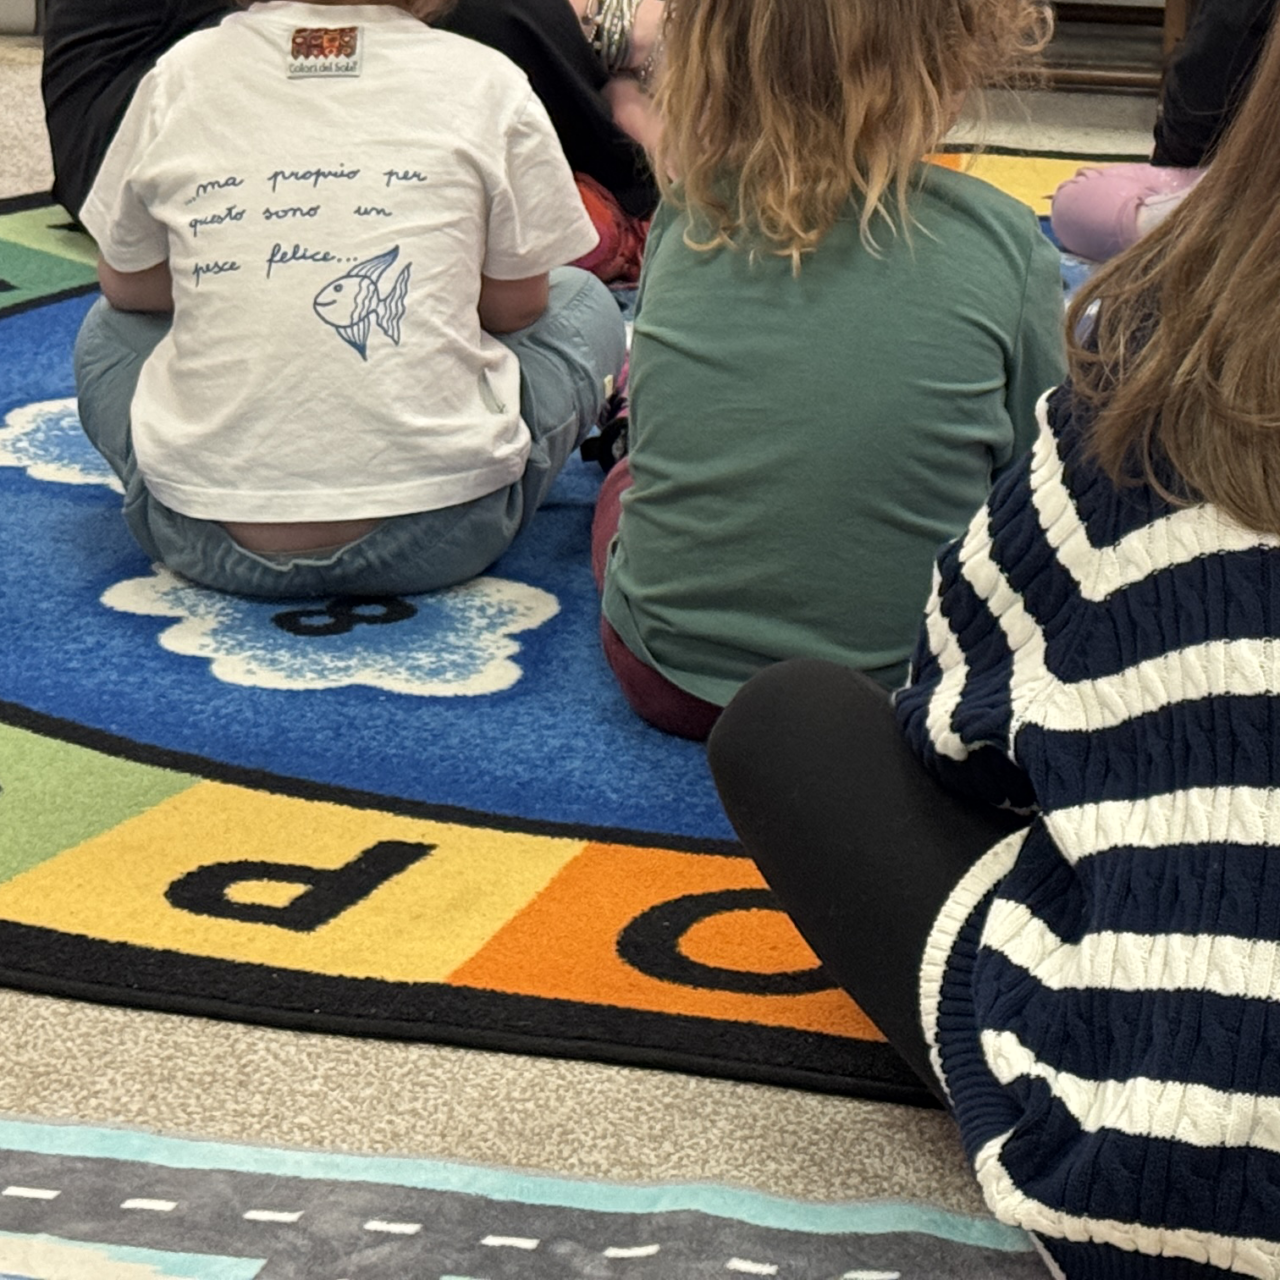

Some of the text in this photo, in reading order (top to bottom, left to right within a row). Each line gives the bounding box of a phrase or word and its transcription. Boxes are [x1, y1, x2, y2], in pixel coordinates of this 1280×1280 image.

[289, 62, 317, 73] Colori
[319, 61, 333, 72] del
[267, 162, 361, 193] proprio
[383, 169, 428, 188] per
[189, 204, 393, 238] questo sono un
[192, 261, 241, 288] pesce
[163, 840, 437, 932] P
